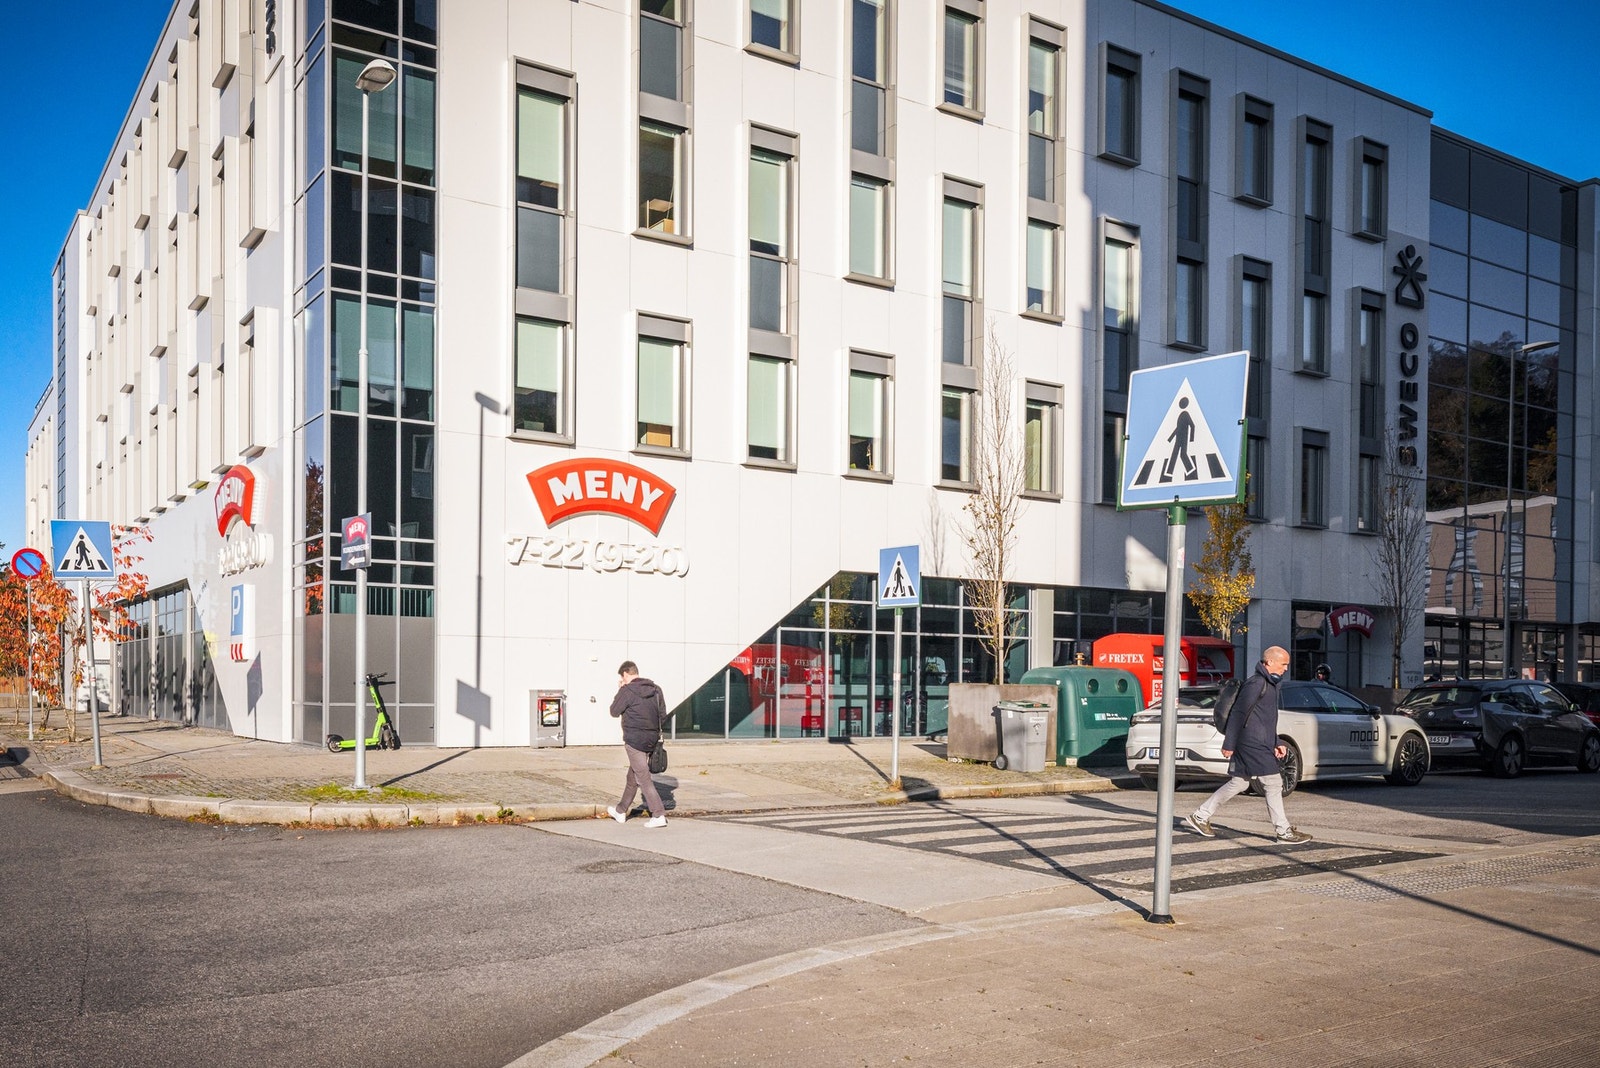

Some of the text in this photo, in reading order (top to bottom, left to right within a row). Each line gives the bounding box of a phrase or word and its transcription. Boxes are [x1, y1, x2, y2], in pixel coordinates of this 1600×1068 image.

[1399, 322, 1419, 467] SWECO
[547, 470, 664, 512] MENY
[348, 521, 366, 537] MENY
[231, 589, 241, 632] P
[1338, 611, 1374, 630] MENY
[1107, 653, 1144, 663] FRETEX
[1350, 726, 1379, 741] mood
